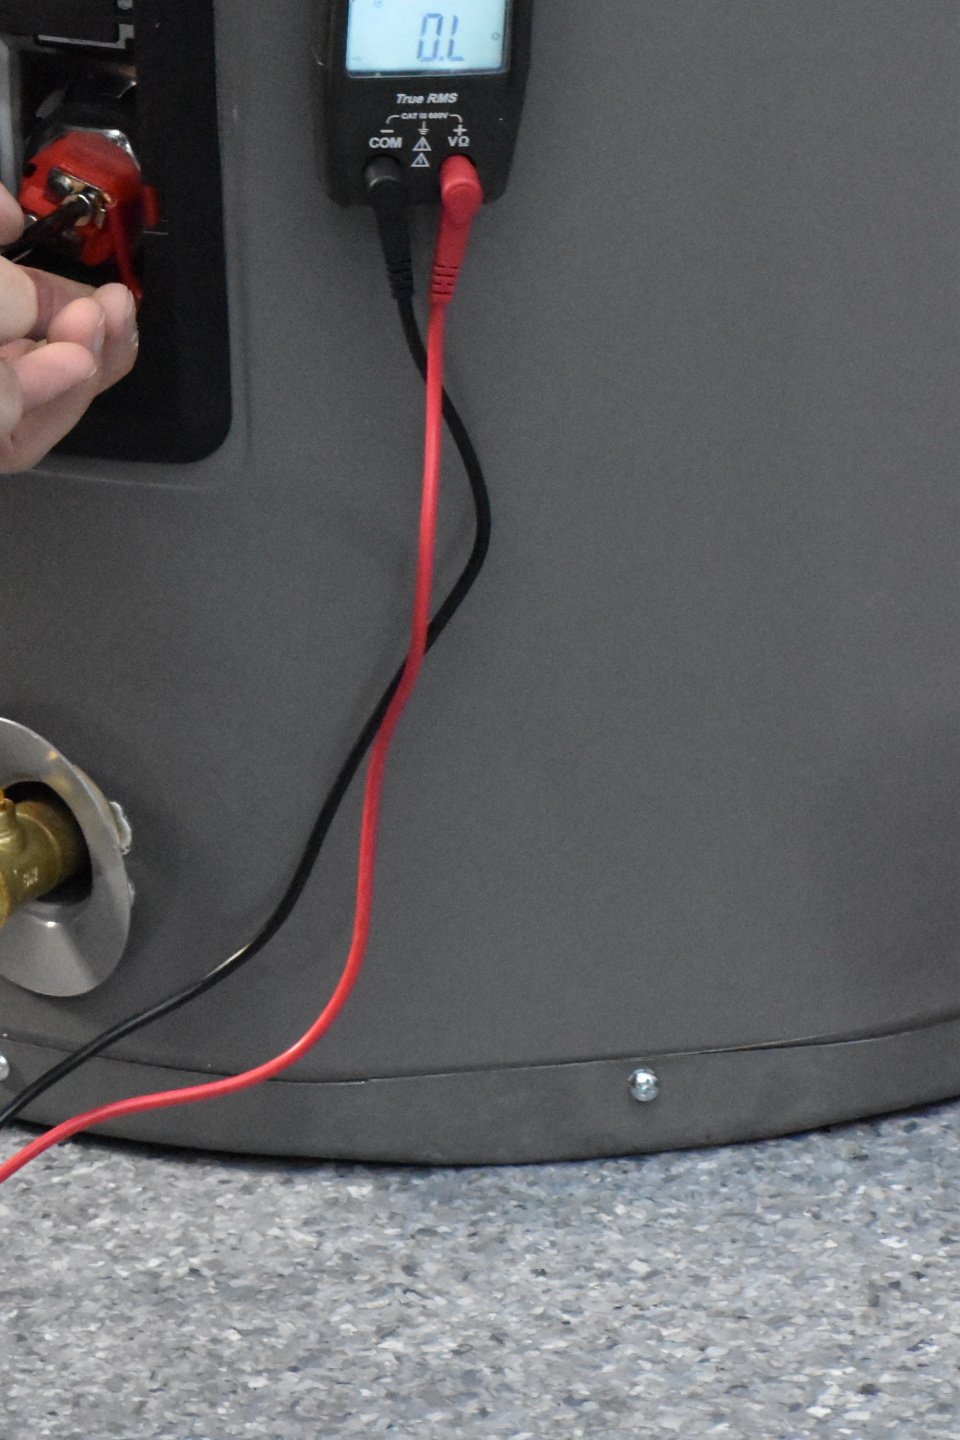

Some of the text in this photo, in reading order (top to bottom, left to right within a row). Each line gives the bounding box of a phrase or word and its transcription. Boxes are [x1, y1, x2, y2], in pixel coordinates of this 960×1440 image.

[396, 93, 458, 103] True RMS
[369, 137, 403, 148] COM
